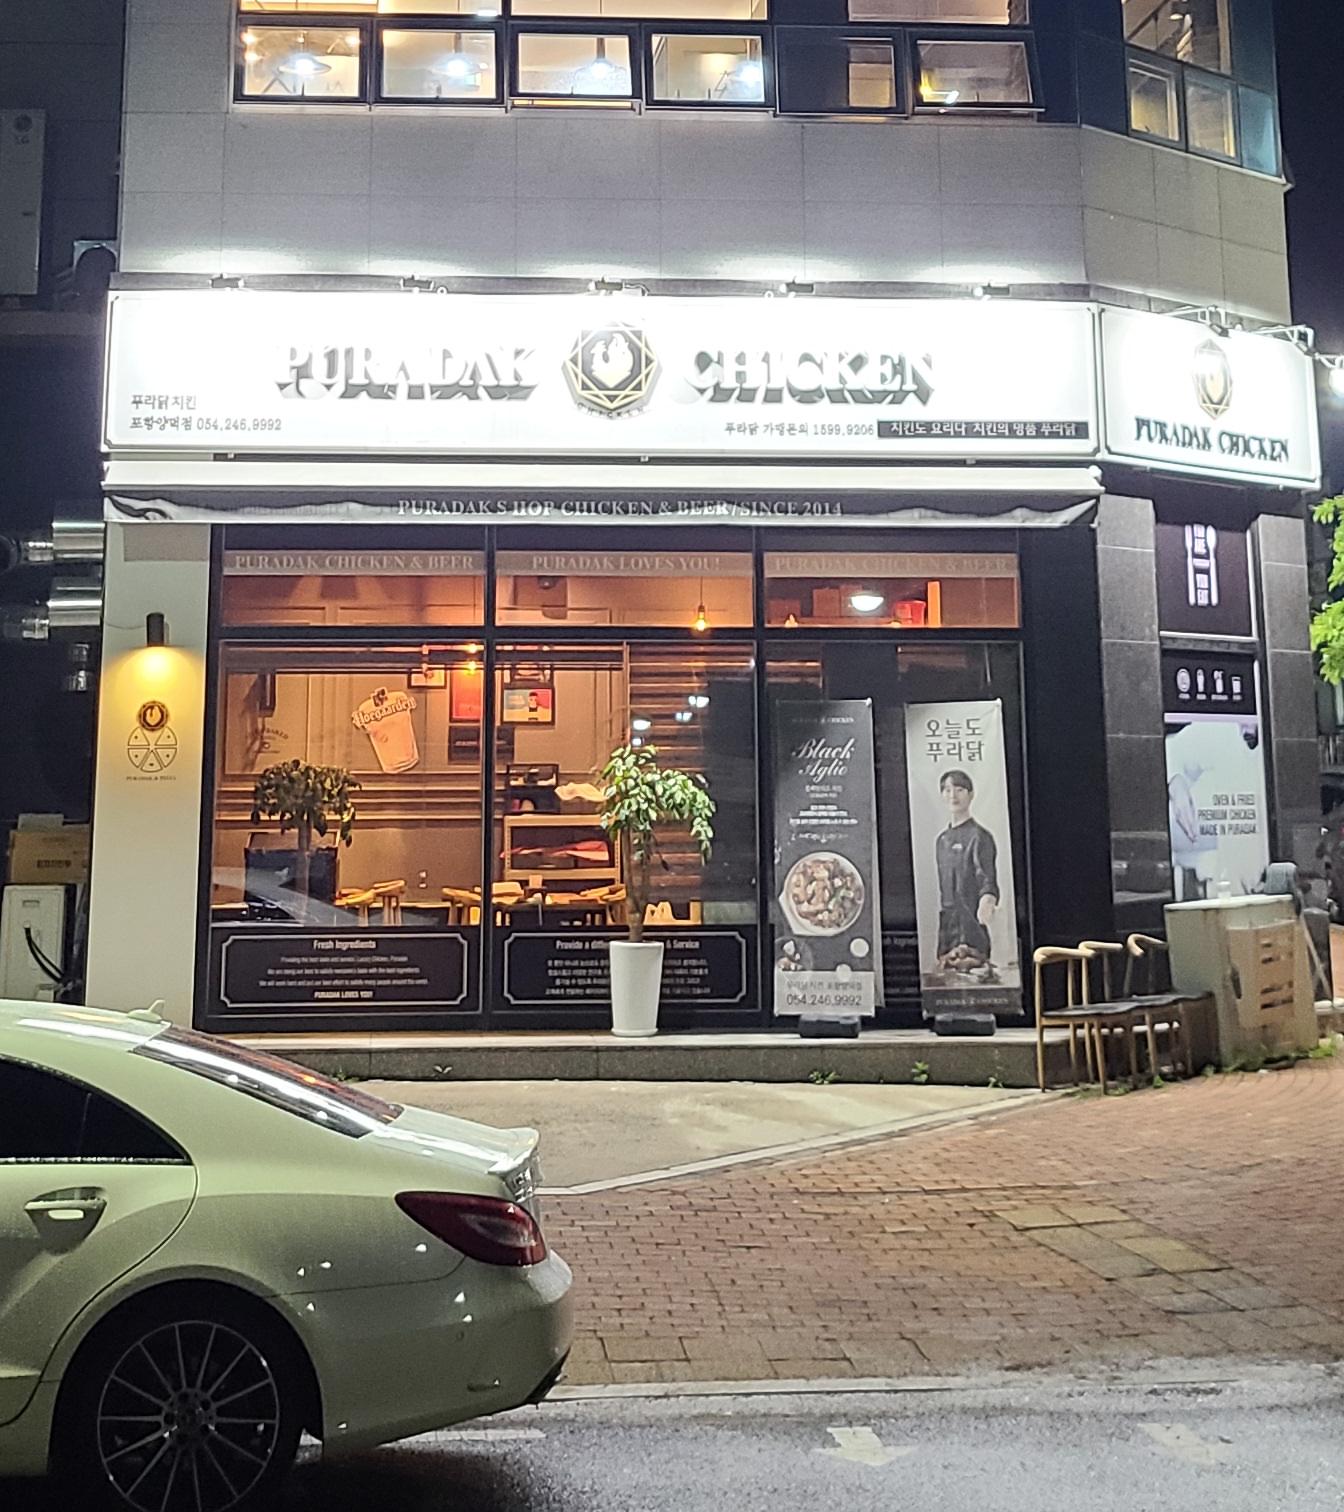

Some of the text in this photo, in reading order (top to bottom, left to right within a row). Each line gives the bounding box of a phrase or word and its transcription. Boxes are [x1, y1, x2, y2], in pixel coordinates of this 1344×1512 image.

[274, 343, 935, 406] PURADAK CHICKEN
[131, 394, 197, 410] 푸라닭 치킨
[1135, 416, 1290, 463] PURADAK CHICKEN
[561, 500, 653, 516] CHICKEN
[658, 500, 672, 516] &
[803, 502, 843, 516] 2014
[235, 555, 474, 569] PURADAK CHICKEN & BEER
[532, 555, 614, 570] PURADAK
[619, 556, 674, 570] LOVES
[925, 718, 982, 739] 오늘도
[792, 738, 855, 759] Black
[926, 740, 984, 762] 푸라닭
[786, 993, 862, 1006] 054.246.9992
